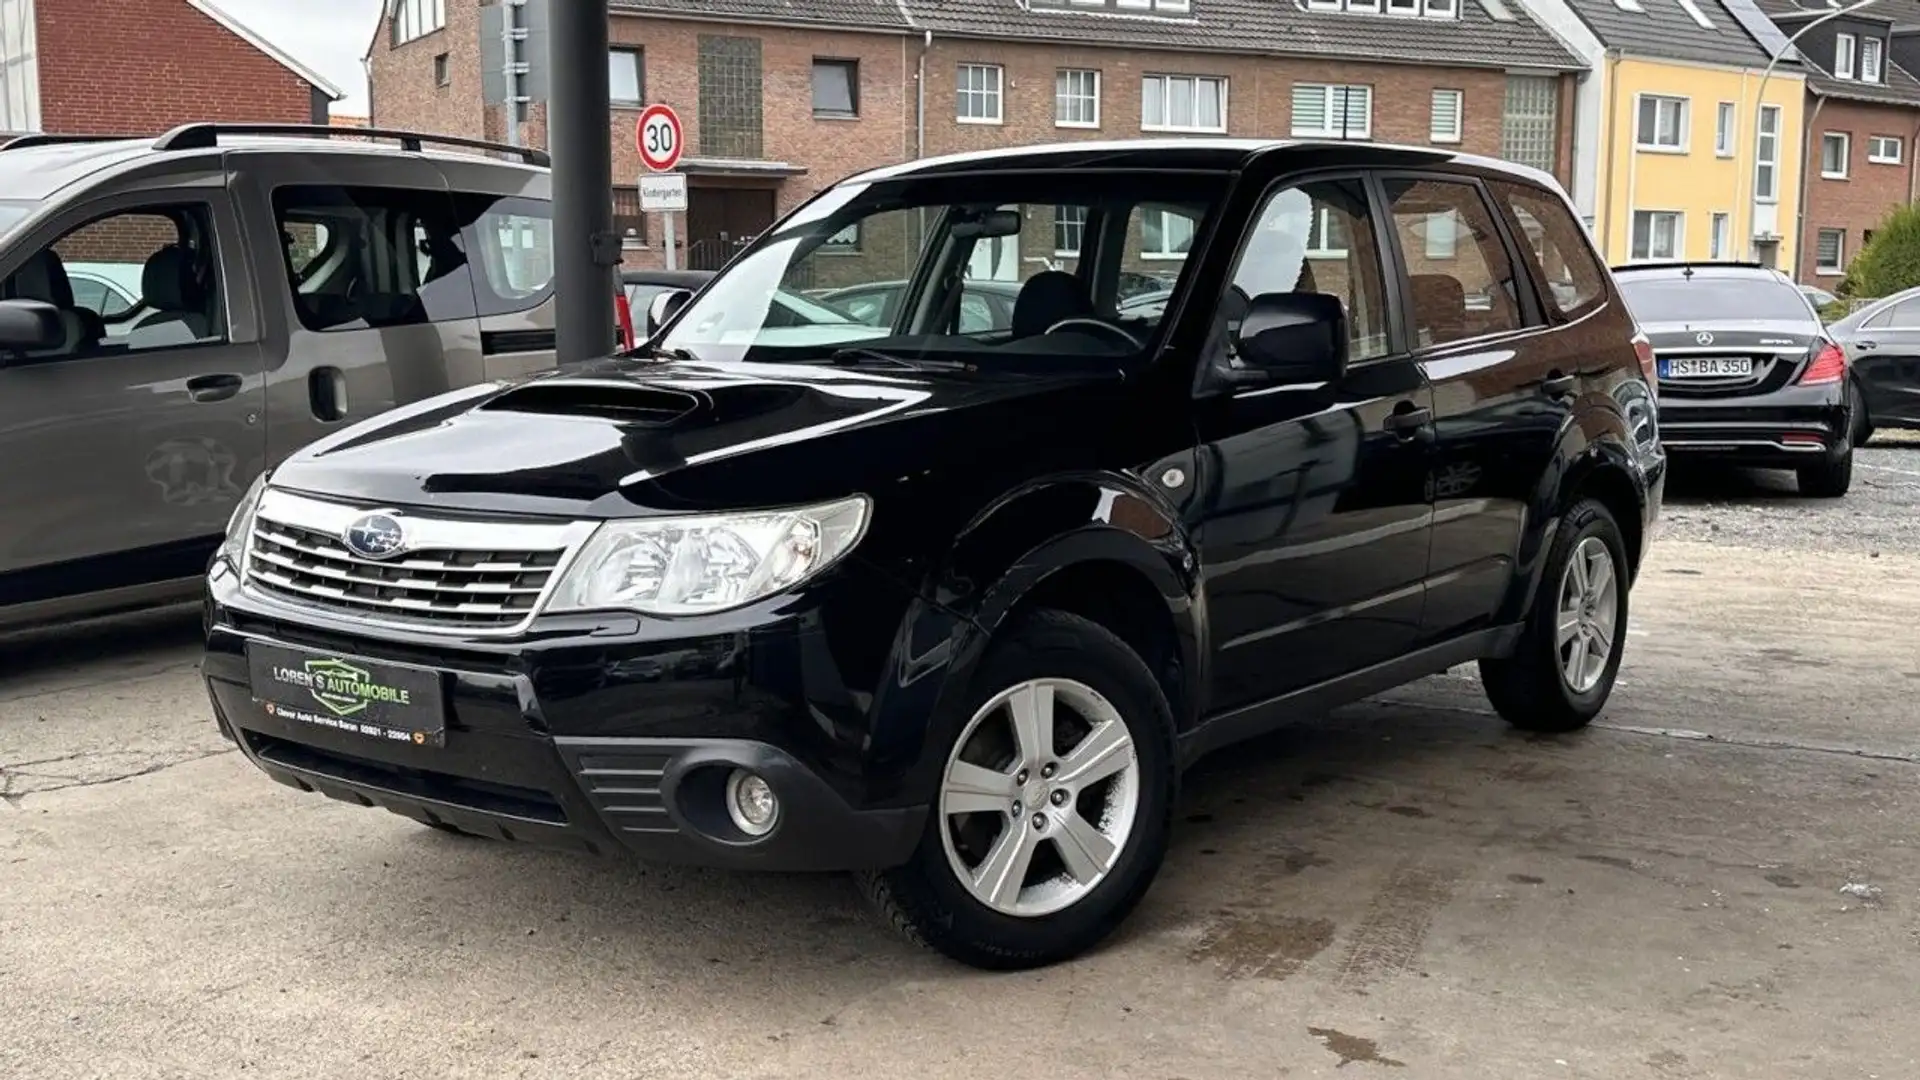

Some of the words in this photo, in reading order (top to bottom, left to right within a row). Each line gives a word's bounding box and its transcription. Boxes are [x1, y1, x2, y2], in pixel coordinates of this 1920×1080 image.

[646, 123, 672, 153] 30
[1670, 360, 1689, 374] HS
[1700, 359, 1719, 373] BA
[1721, 359, 1750, 373] 350
[327, 677, 410, 704] AUTOMOBILE
[313, 715, 338, 728] Service
